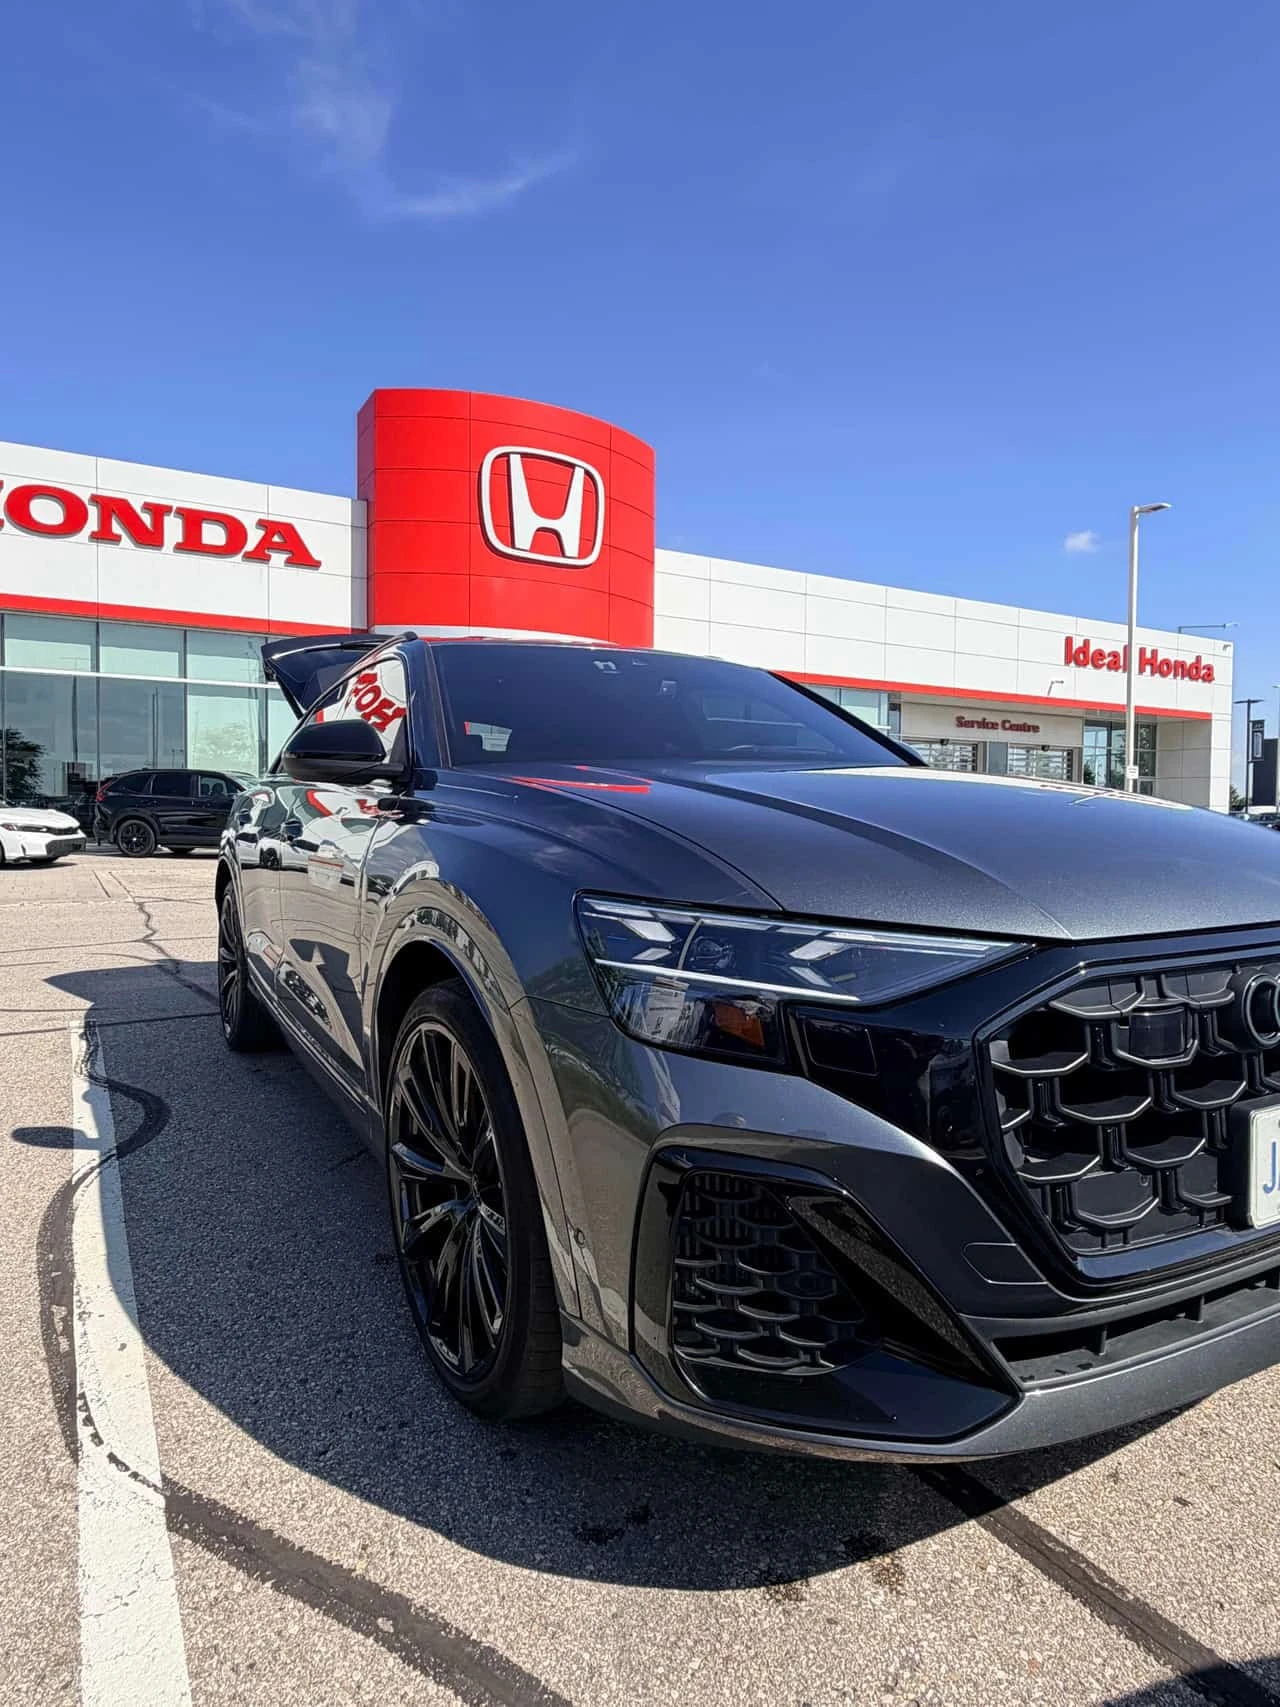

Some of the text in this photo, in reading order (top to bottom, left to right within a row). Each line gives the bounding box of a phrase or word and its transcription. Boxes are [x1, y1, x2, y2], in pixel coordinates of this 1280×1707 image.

[0, 480, 322, 569] ONDA
[1064, 635, 1215, 683] Ideal Honda
[955, 715, 1041, 734] Service Centre
[1262, 1141, 1280, 1194] J
